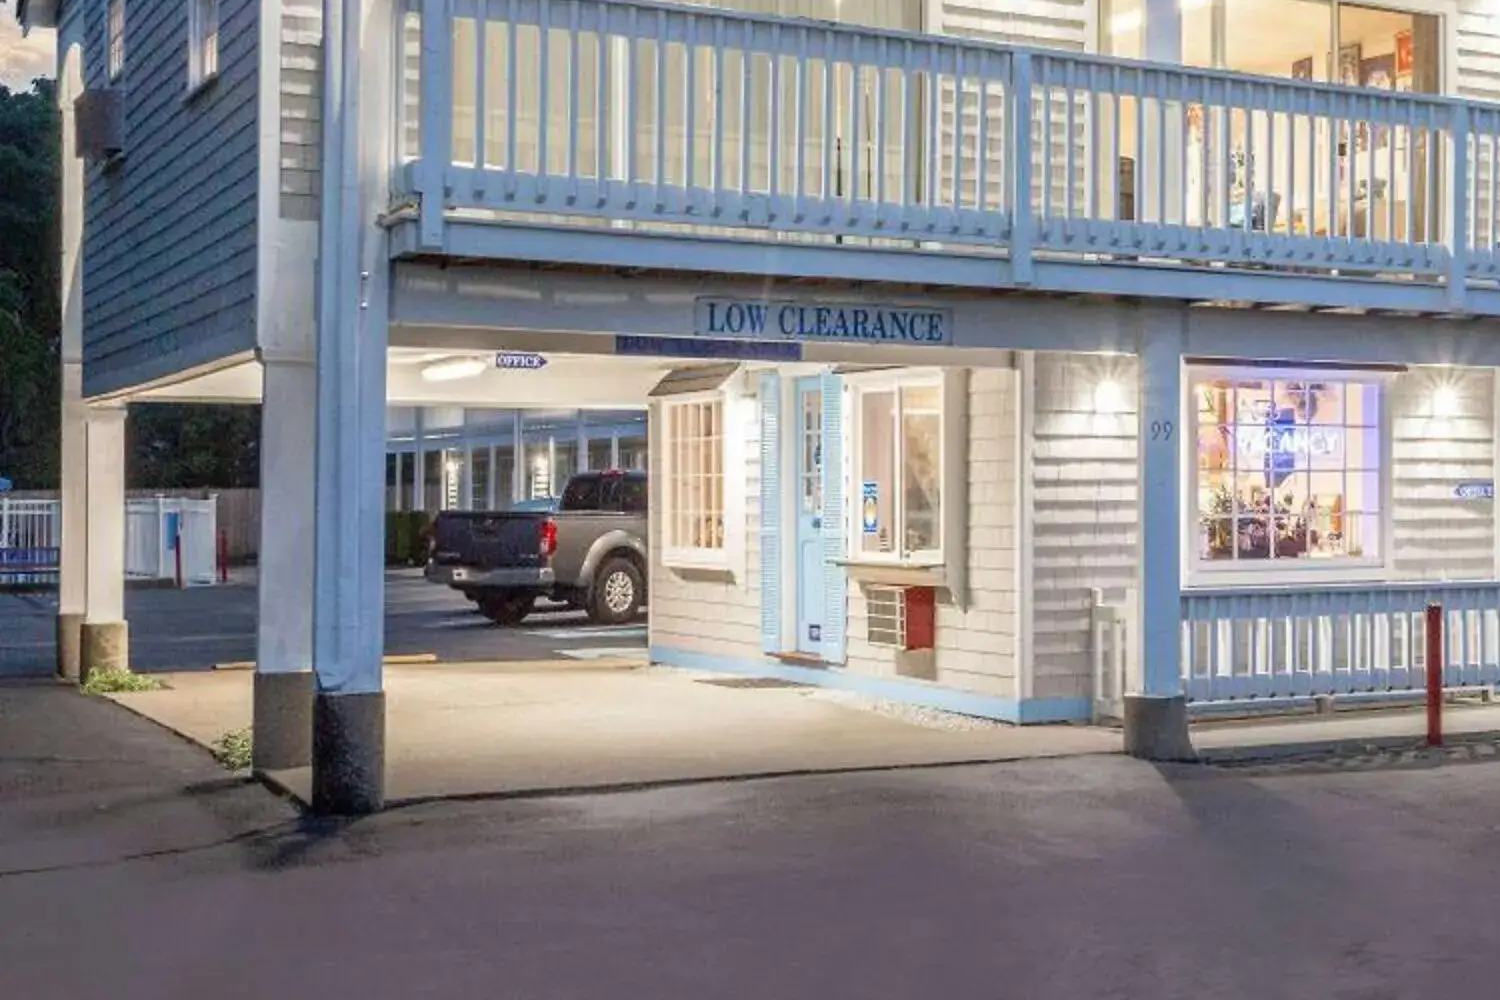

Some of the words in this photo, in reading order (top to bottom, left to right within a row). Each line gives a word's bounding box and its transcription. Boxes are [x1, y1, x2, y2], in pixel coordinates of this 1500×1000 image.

[708, 303, 769, 335] LOW
[779, 305, 943, 341] CLEARANCE
[497, 354, 541, 367] OFFICE
[1151, 420, 1173, 441] 99
